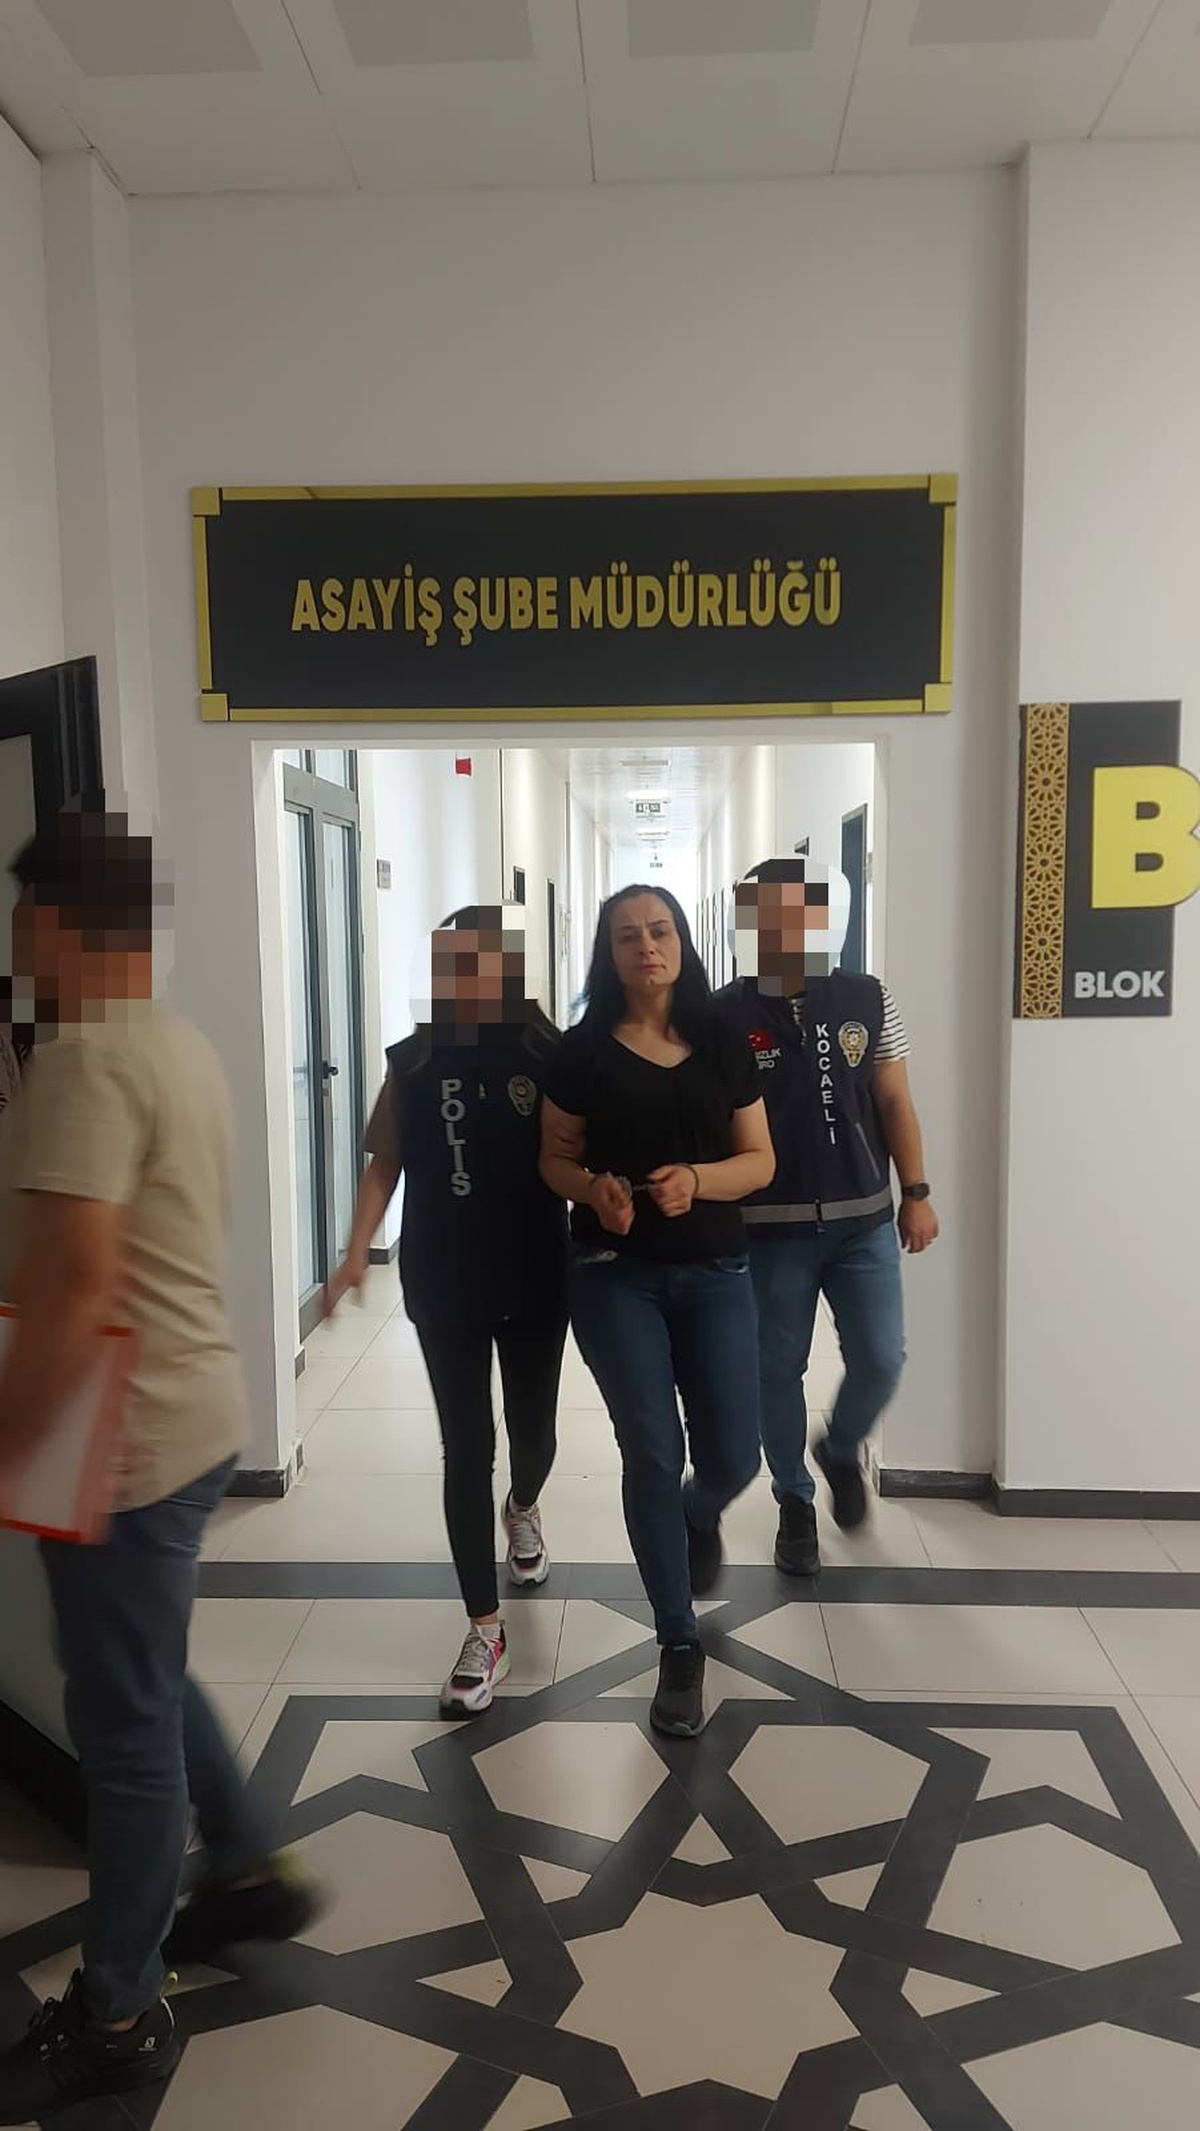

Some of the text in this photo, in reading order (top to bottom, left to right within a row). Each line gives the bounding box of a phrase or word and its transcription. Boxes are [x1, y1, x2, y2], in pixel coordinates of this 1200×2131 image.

[291, 557, 842, 647] ASAYİŞ ŞUBE MÜDÜRLÜĞÜ
[1091, 764, 1200, 910] B
[1074, 970, 1166, 999] BLOK
[815, 1023, 837, 1145] KOCAELİ
